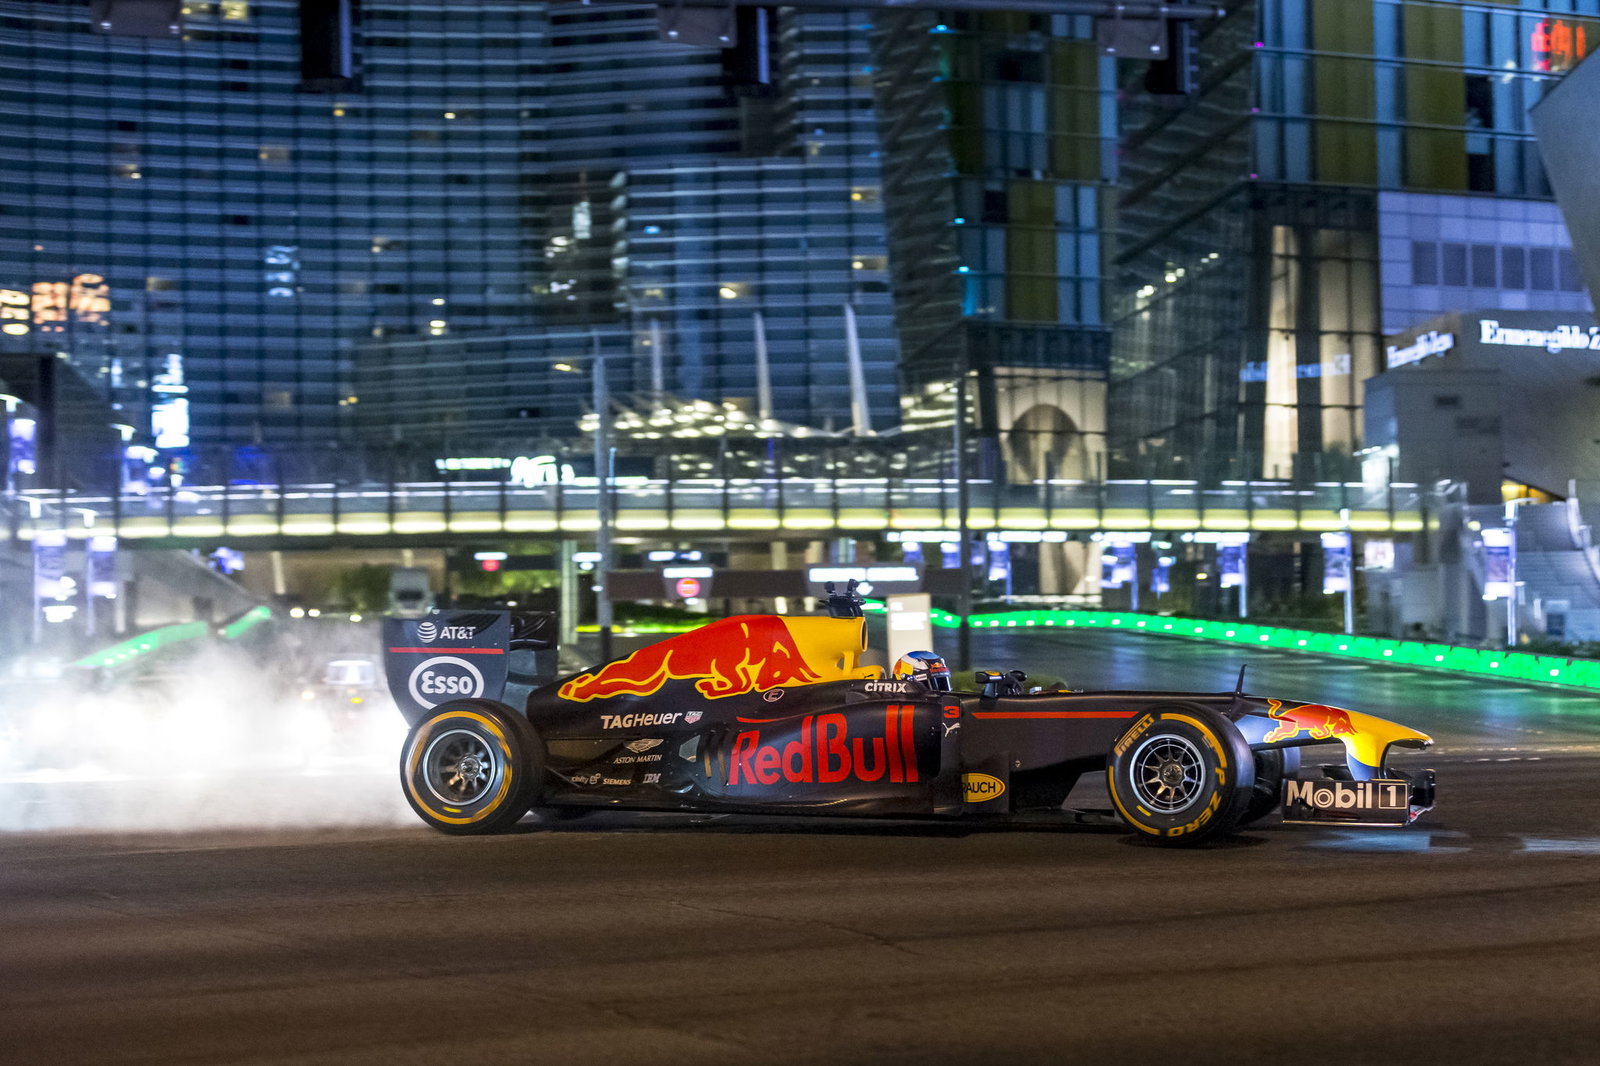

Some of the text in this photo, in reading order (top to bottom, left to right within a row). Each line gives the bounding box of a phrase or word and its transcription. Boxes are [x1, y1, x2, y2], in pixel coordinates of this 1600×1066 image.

[440, 626, 476, 640] AT&T
[421, 670, 473, 694] Esso
[865, 679, 907, 693] CITRIX
[944, 705, 960, 718] 3
[1114, 713, 1155, 757] PIRELLI
[613, 754, 663, 764] ASTON MARTIN
[603, 778, 631, 786] SIEMENS
[642, 773, 661, 784] IBM
[1167, 767, 1226, 837] P ZERO
[1286, 781, 1373, 809] Mobil
